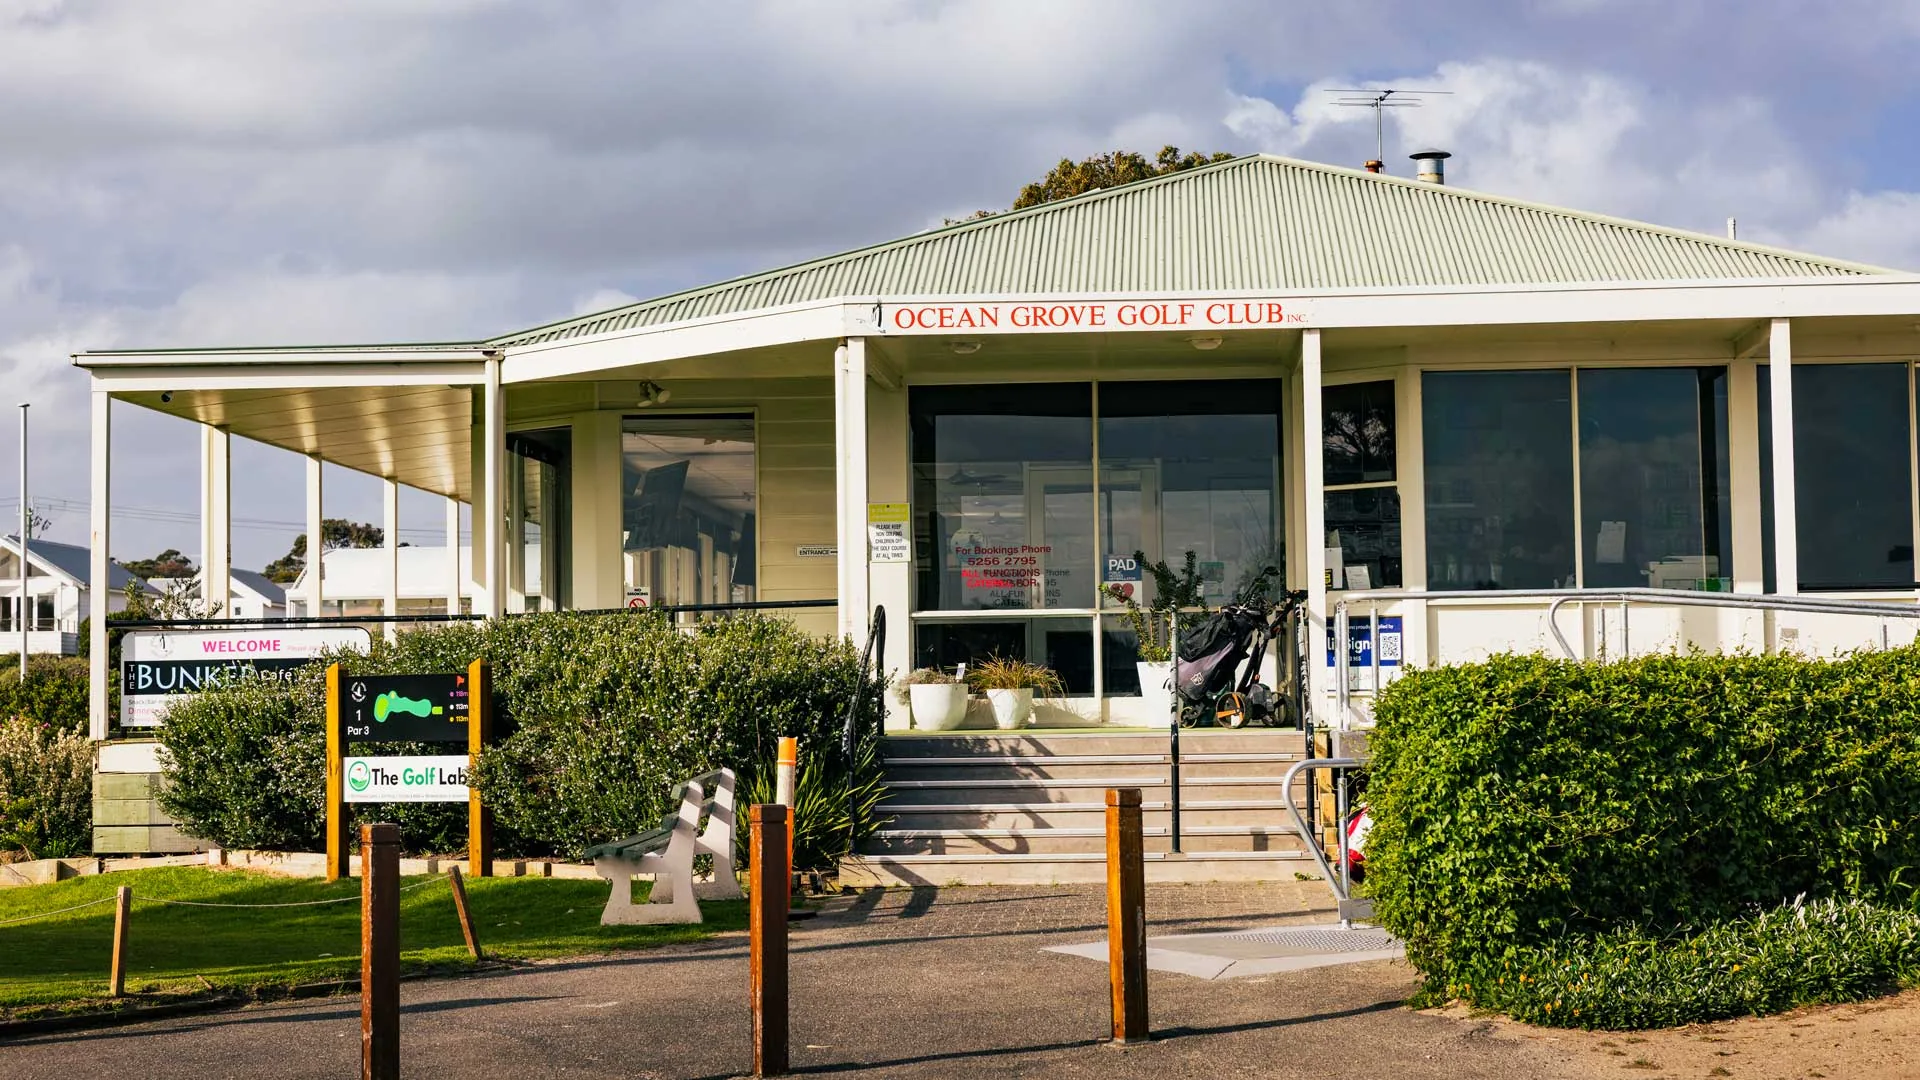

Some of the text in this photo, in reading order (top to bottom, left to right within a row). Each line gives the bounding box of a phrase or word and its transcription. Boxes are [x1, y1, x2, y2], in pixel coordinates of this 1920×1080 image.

[895, 303, 1309, 329] OCEAN GROVE GOLF CLUB INC.
[955, 545, 1052, 556] For Bookings Phone
[967, 557, 1037, 566] 5256 2795
[1108, 559, 1137, 571] PAD
[984, 568, 1041, 578] FUNCTIONS
[202, 640, 281, 653] WELCOME
[128, 664, 136, 690] THE
[356, 709, 361, 721] 1
[347, 725, 370, 736] Par 3
[371, 767, 467, 786] The Golf Lab
